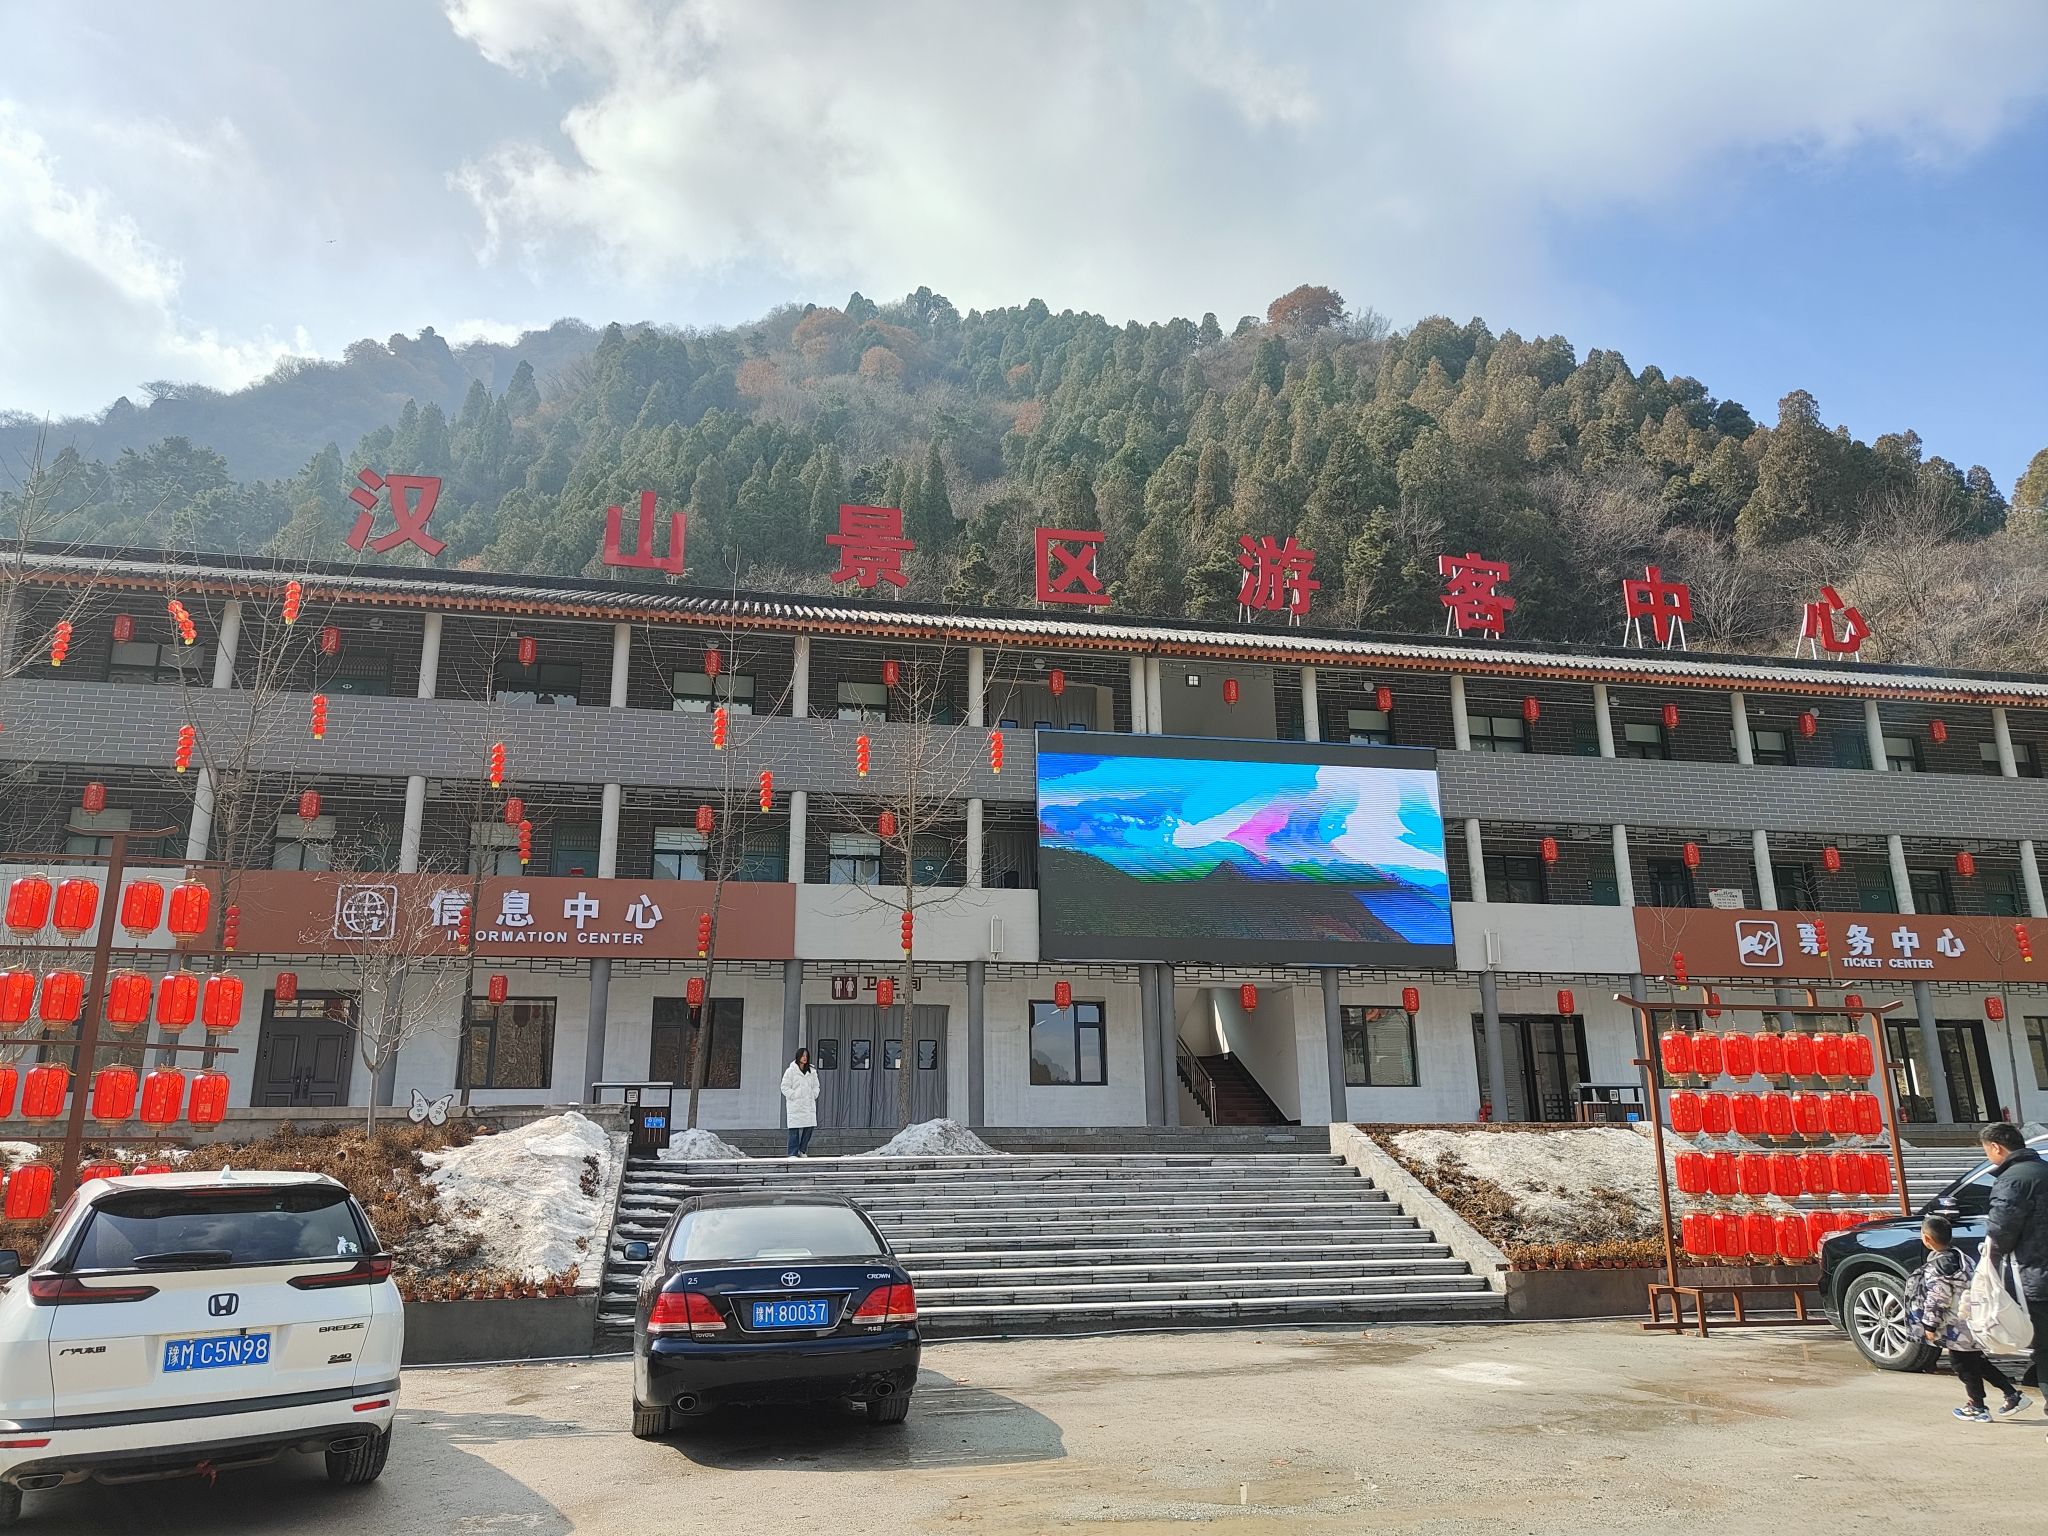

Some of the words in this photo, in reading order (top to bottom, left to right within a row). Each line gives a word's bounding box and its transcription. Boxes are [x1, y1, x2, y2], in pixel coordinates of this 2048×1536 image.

[346, 467, 1866, 654] 汉山景区游客中心
[430, 889, 663, 929] 信息中心
[447, 930, 567, 943] INORMATION
[577, 932, 644, 944] CENTER
[1796, 923, 1966, 958] 票务中心
[1841, 957, 1883, 968] TICKET
[1888, 958, 1935, 969] CENTER
[318, 1322, 365, 1333] BREEZE
[59, 1346, 106, 1356] 广汽本田
[329, 1352, 352, 1361] 240
